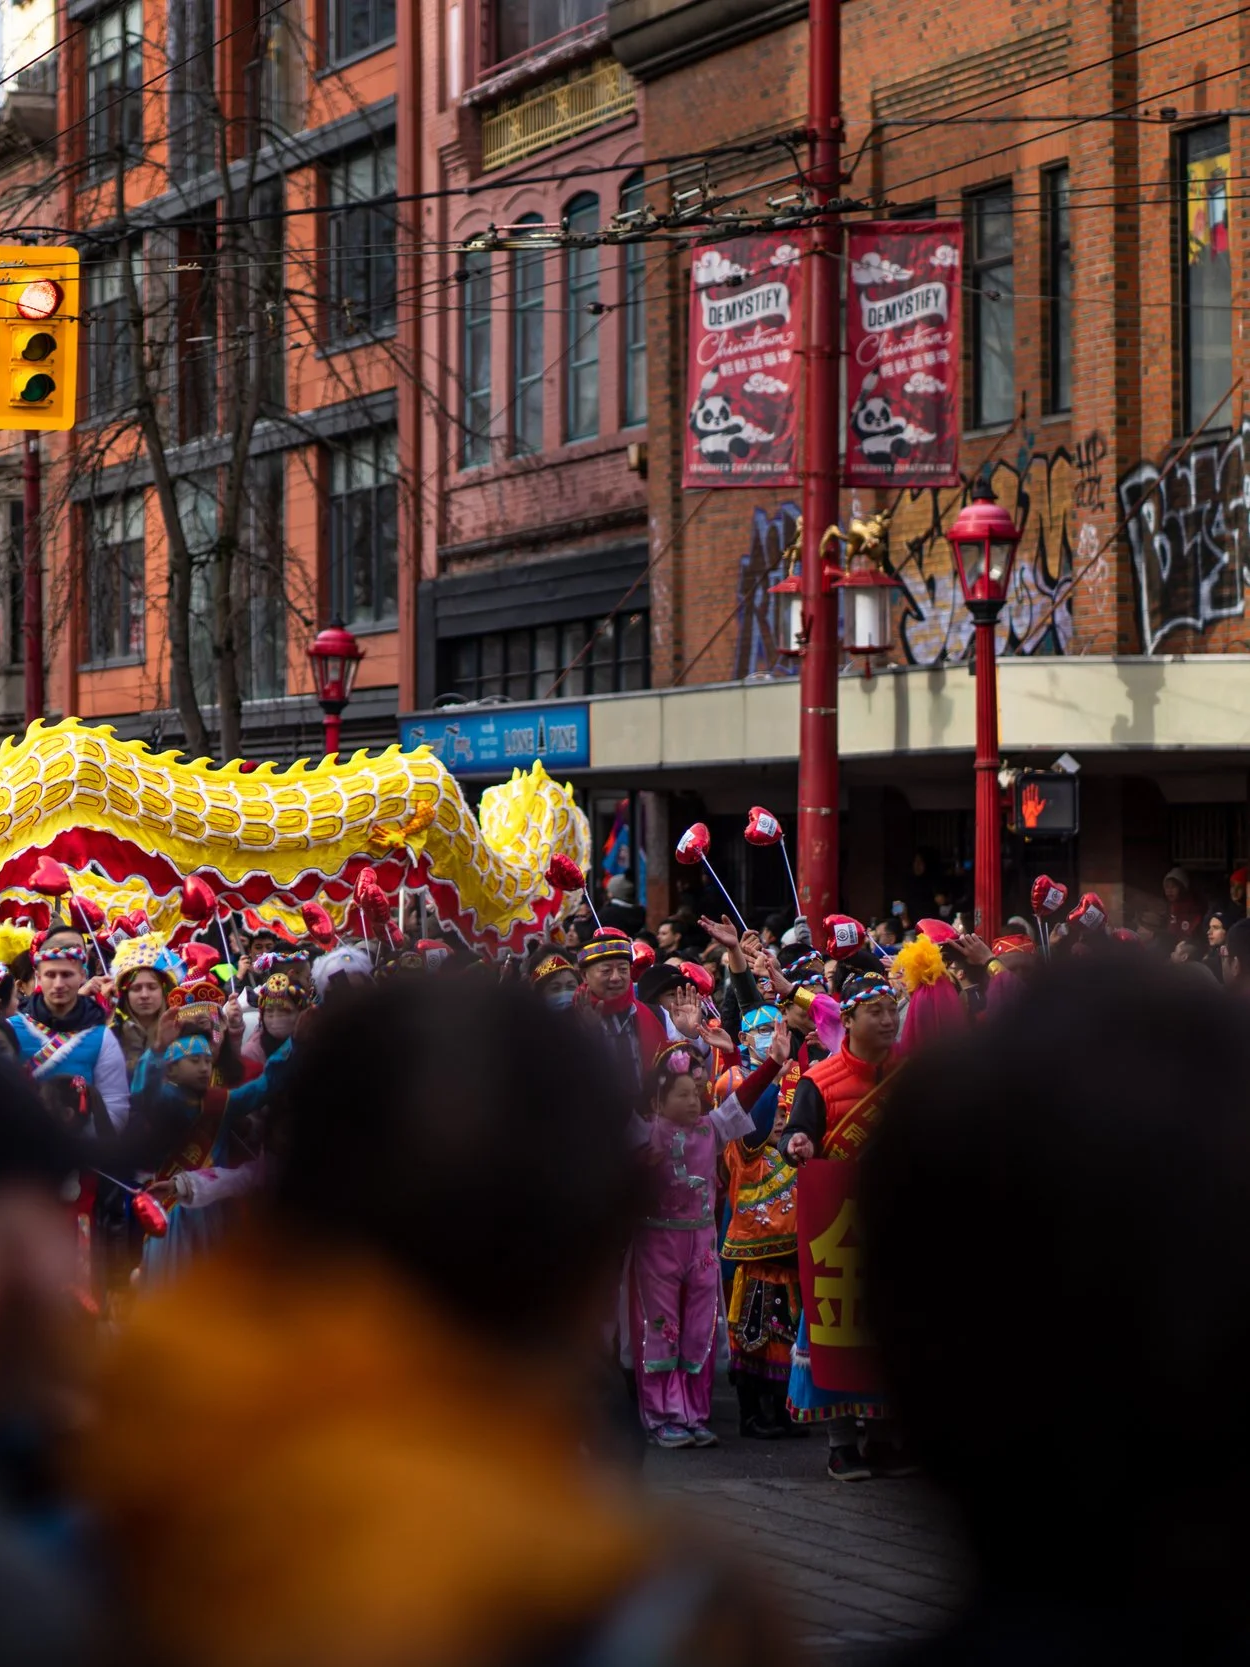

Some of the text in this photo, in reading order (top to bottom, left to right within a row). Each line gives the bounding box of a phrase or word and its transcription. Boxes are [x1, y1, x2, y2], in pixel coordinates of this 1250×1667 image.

[708, 288, 782, 326] DEMYSTIFY
[868, 288, 941, 327] DEMYSTIFY
[696, 325, 795, 366] Chinatown
[856, 324, 953, 367] Chinatown
[504, 727, 534, 757] LONE
[549, 723, 578, 754] PINE
